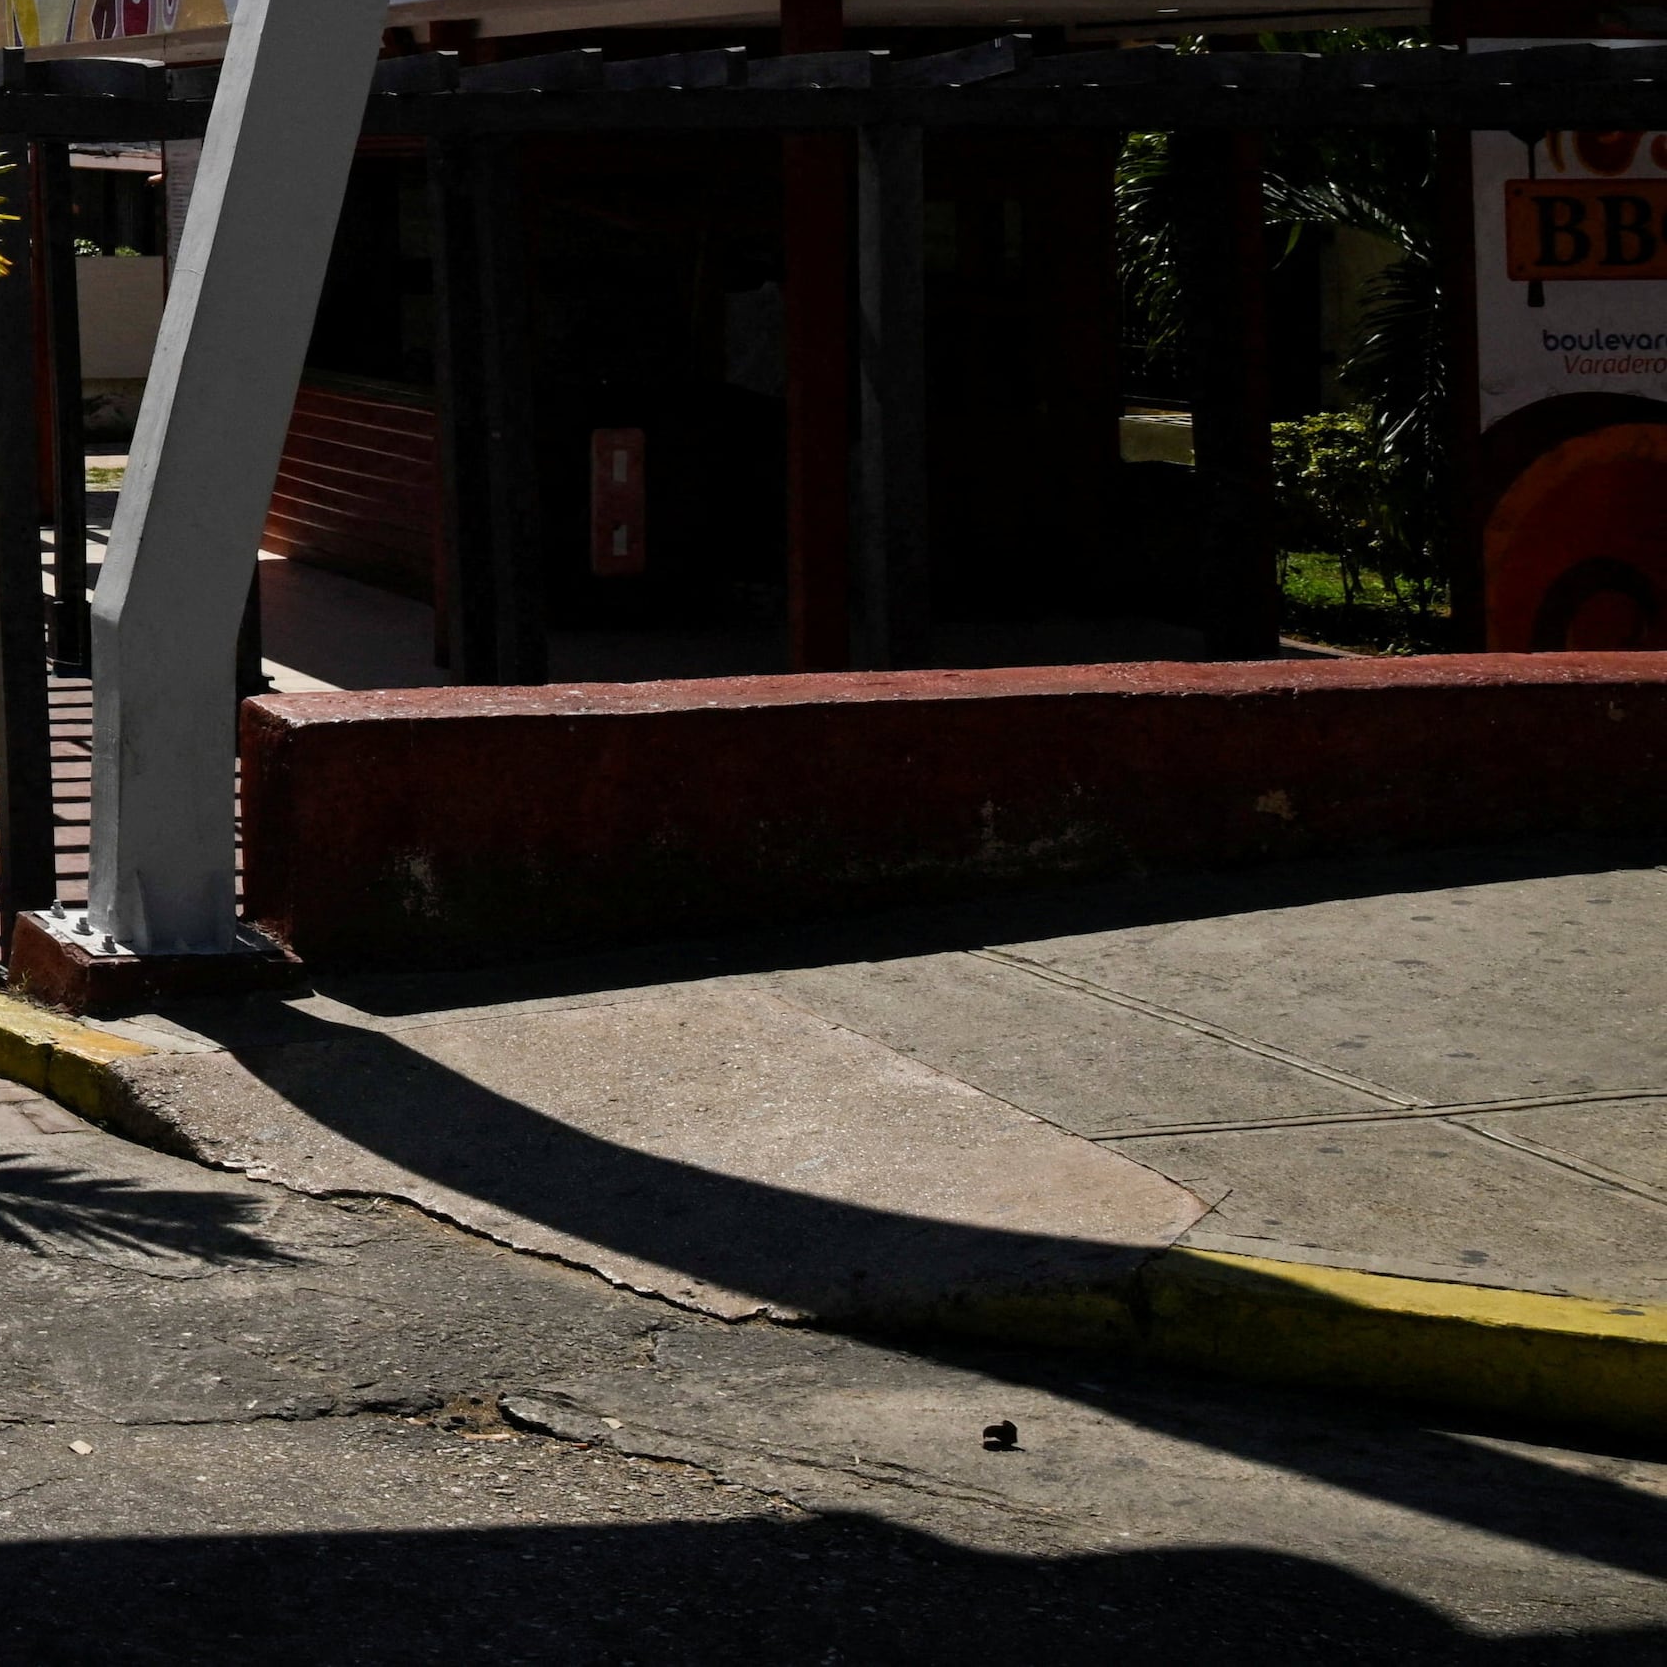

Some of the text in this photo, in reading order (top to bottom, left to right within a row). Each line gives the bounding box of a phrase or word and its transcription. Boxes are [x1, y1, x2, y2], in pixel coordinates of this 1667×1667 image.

[1531, 195, 1667, 266] BB
[1543, 328, 1667, 351] boulevar
[1565, 355, 1667, 374] Varadero
